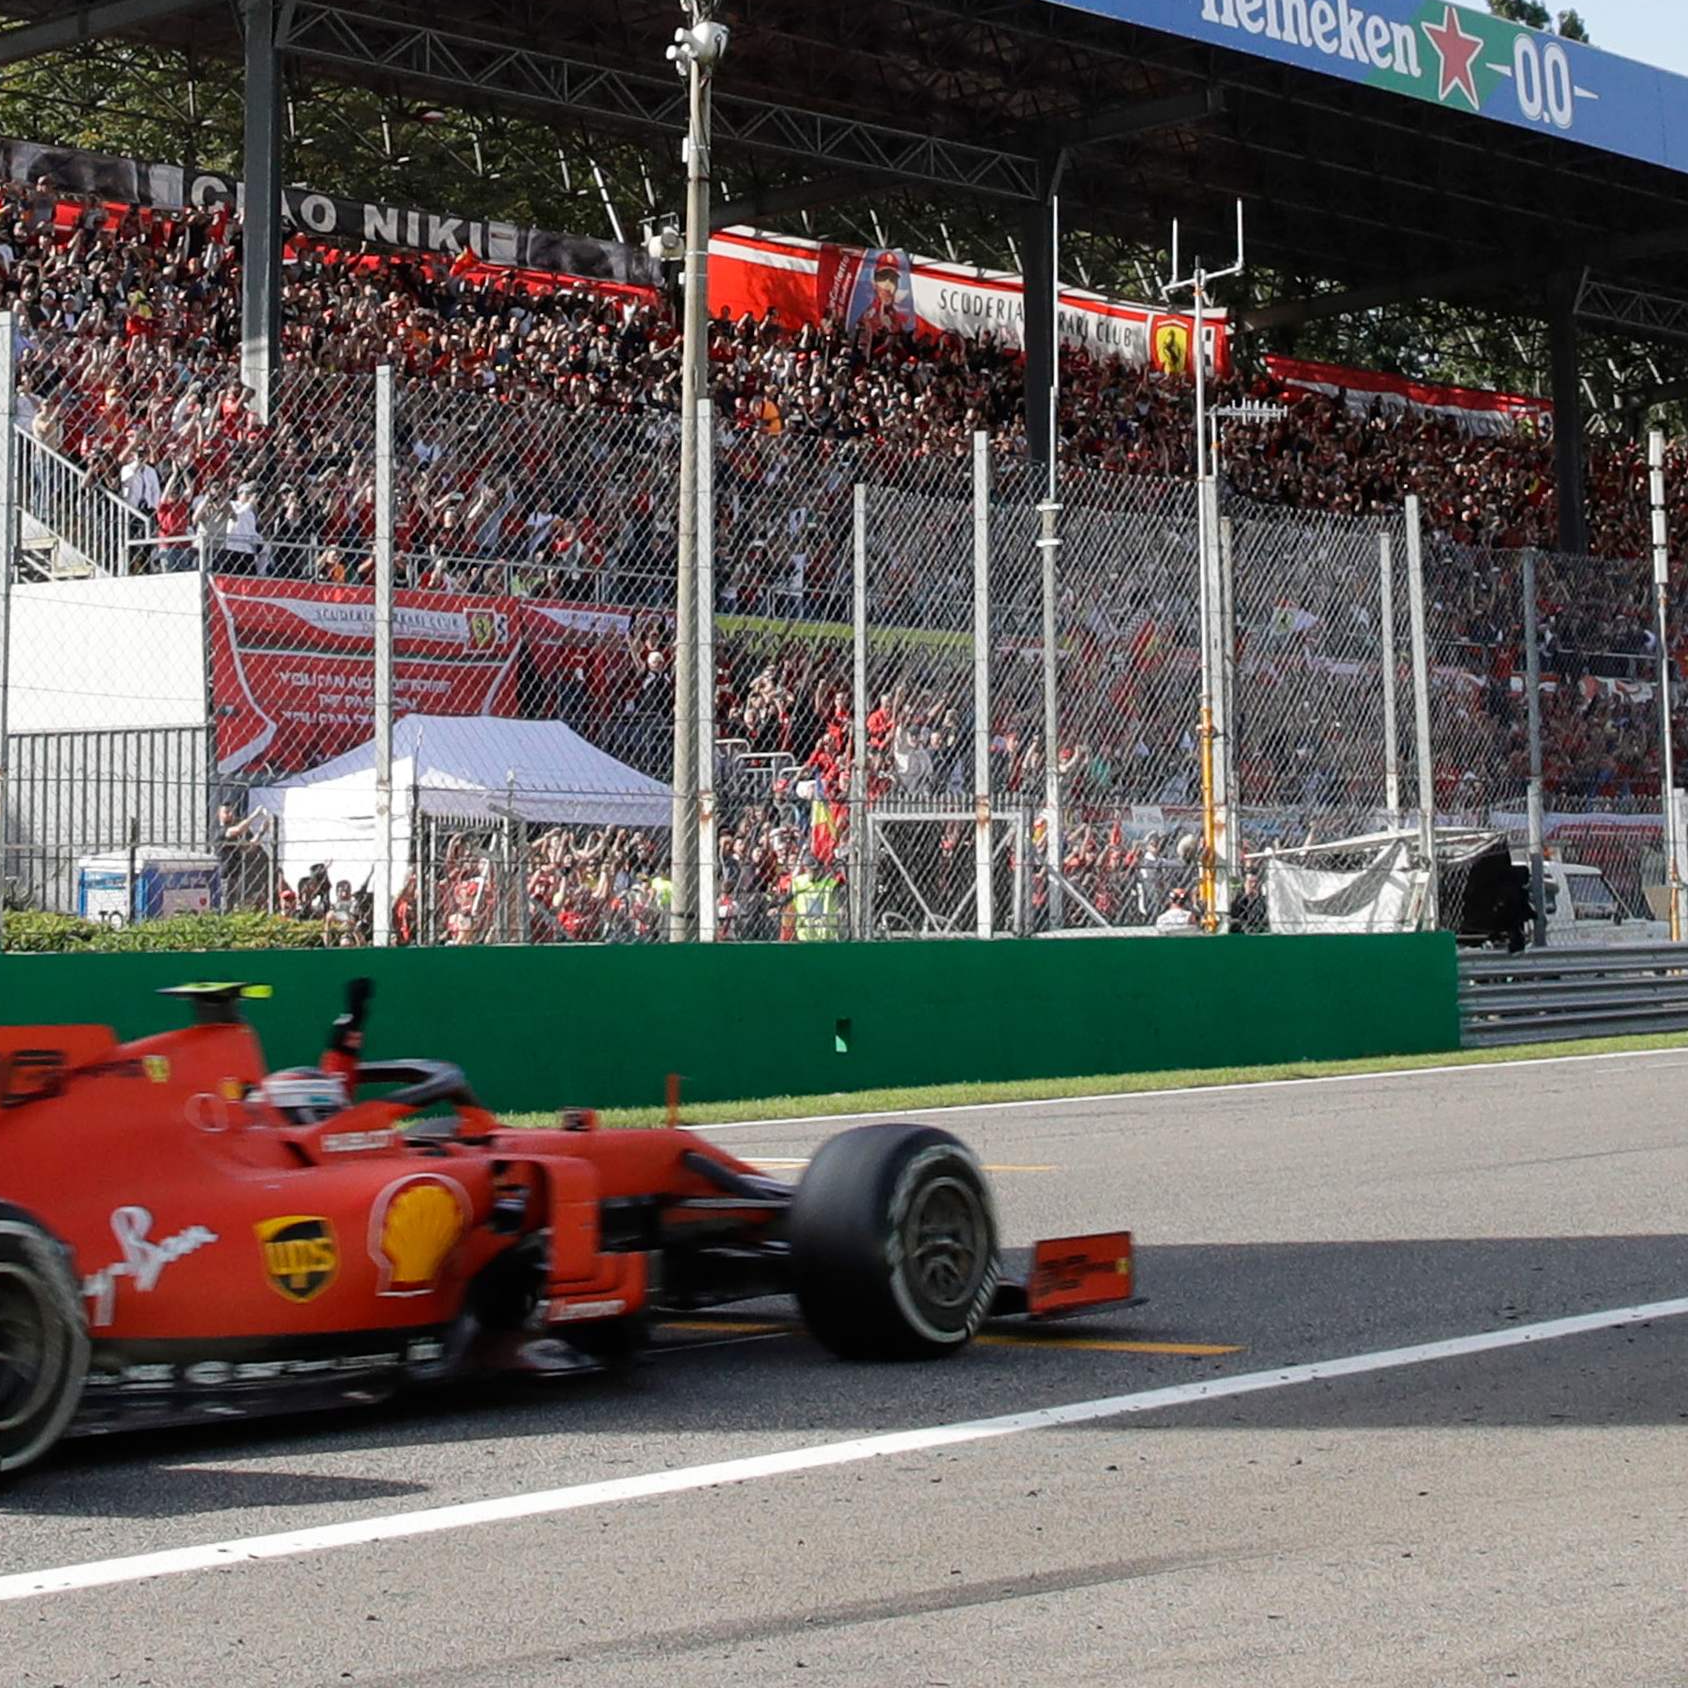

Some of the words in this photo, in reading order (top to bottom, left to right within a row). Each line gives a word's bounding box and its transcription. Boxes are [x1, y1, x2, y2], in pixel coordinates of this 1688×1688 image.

[363, 204, 482, 260] NIKI
[938, 288, 1024, 322] SCUDERIA
[1096, 321, 1132, 348] CLUB
